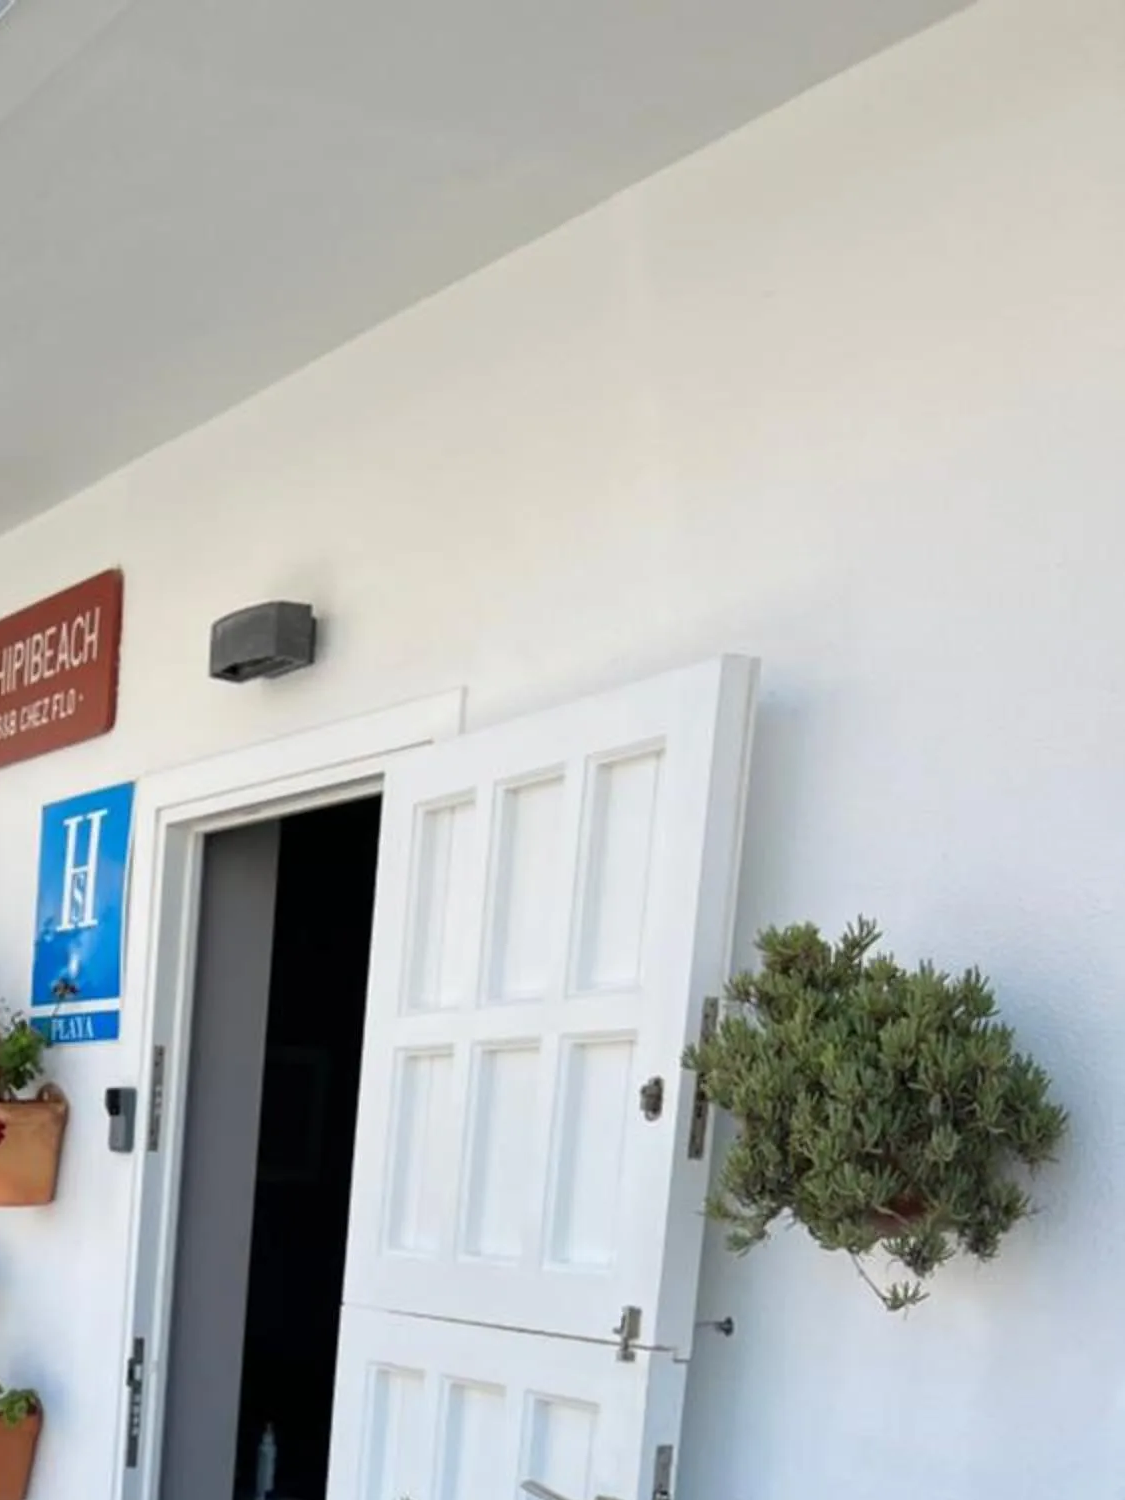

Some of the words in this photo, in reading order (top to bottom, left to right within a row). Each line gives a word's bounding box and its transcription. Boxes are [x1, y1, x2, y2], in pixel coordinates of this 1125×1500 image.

[19, 697, 50, 732] CHEZ
[50, 688, 76, 721] FLO
[51, 1015, 95, 1041] PLAYA
